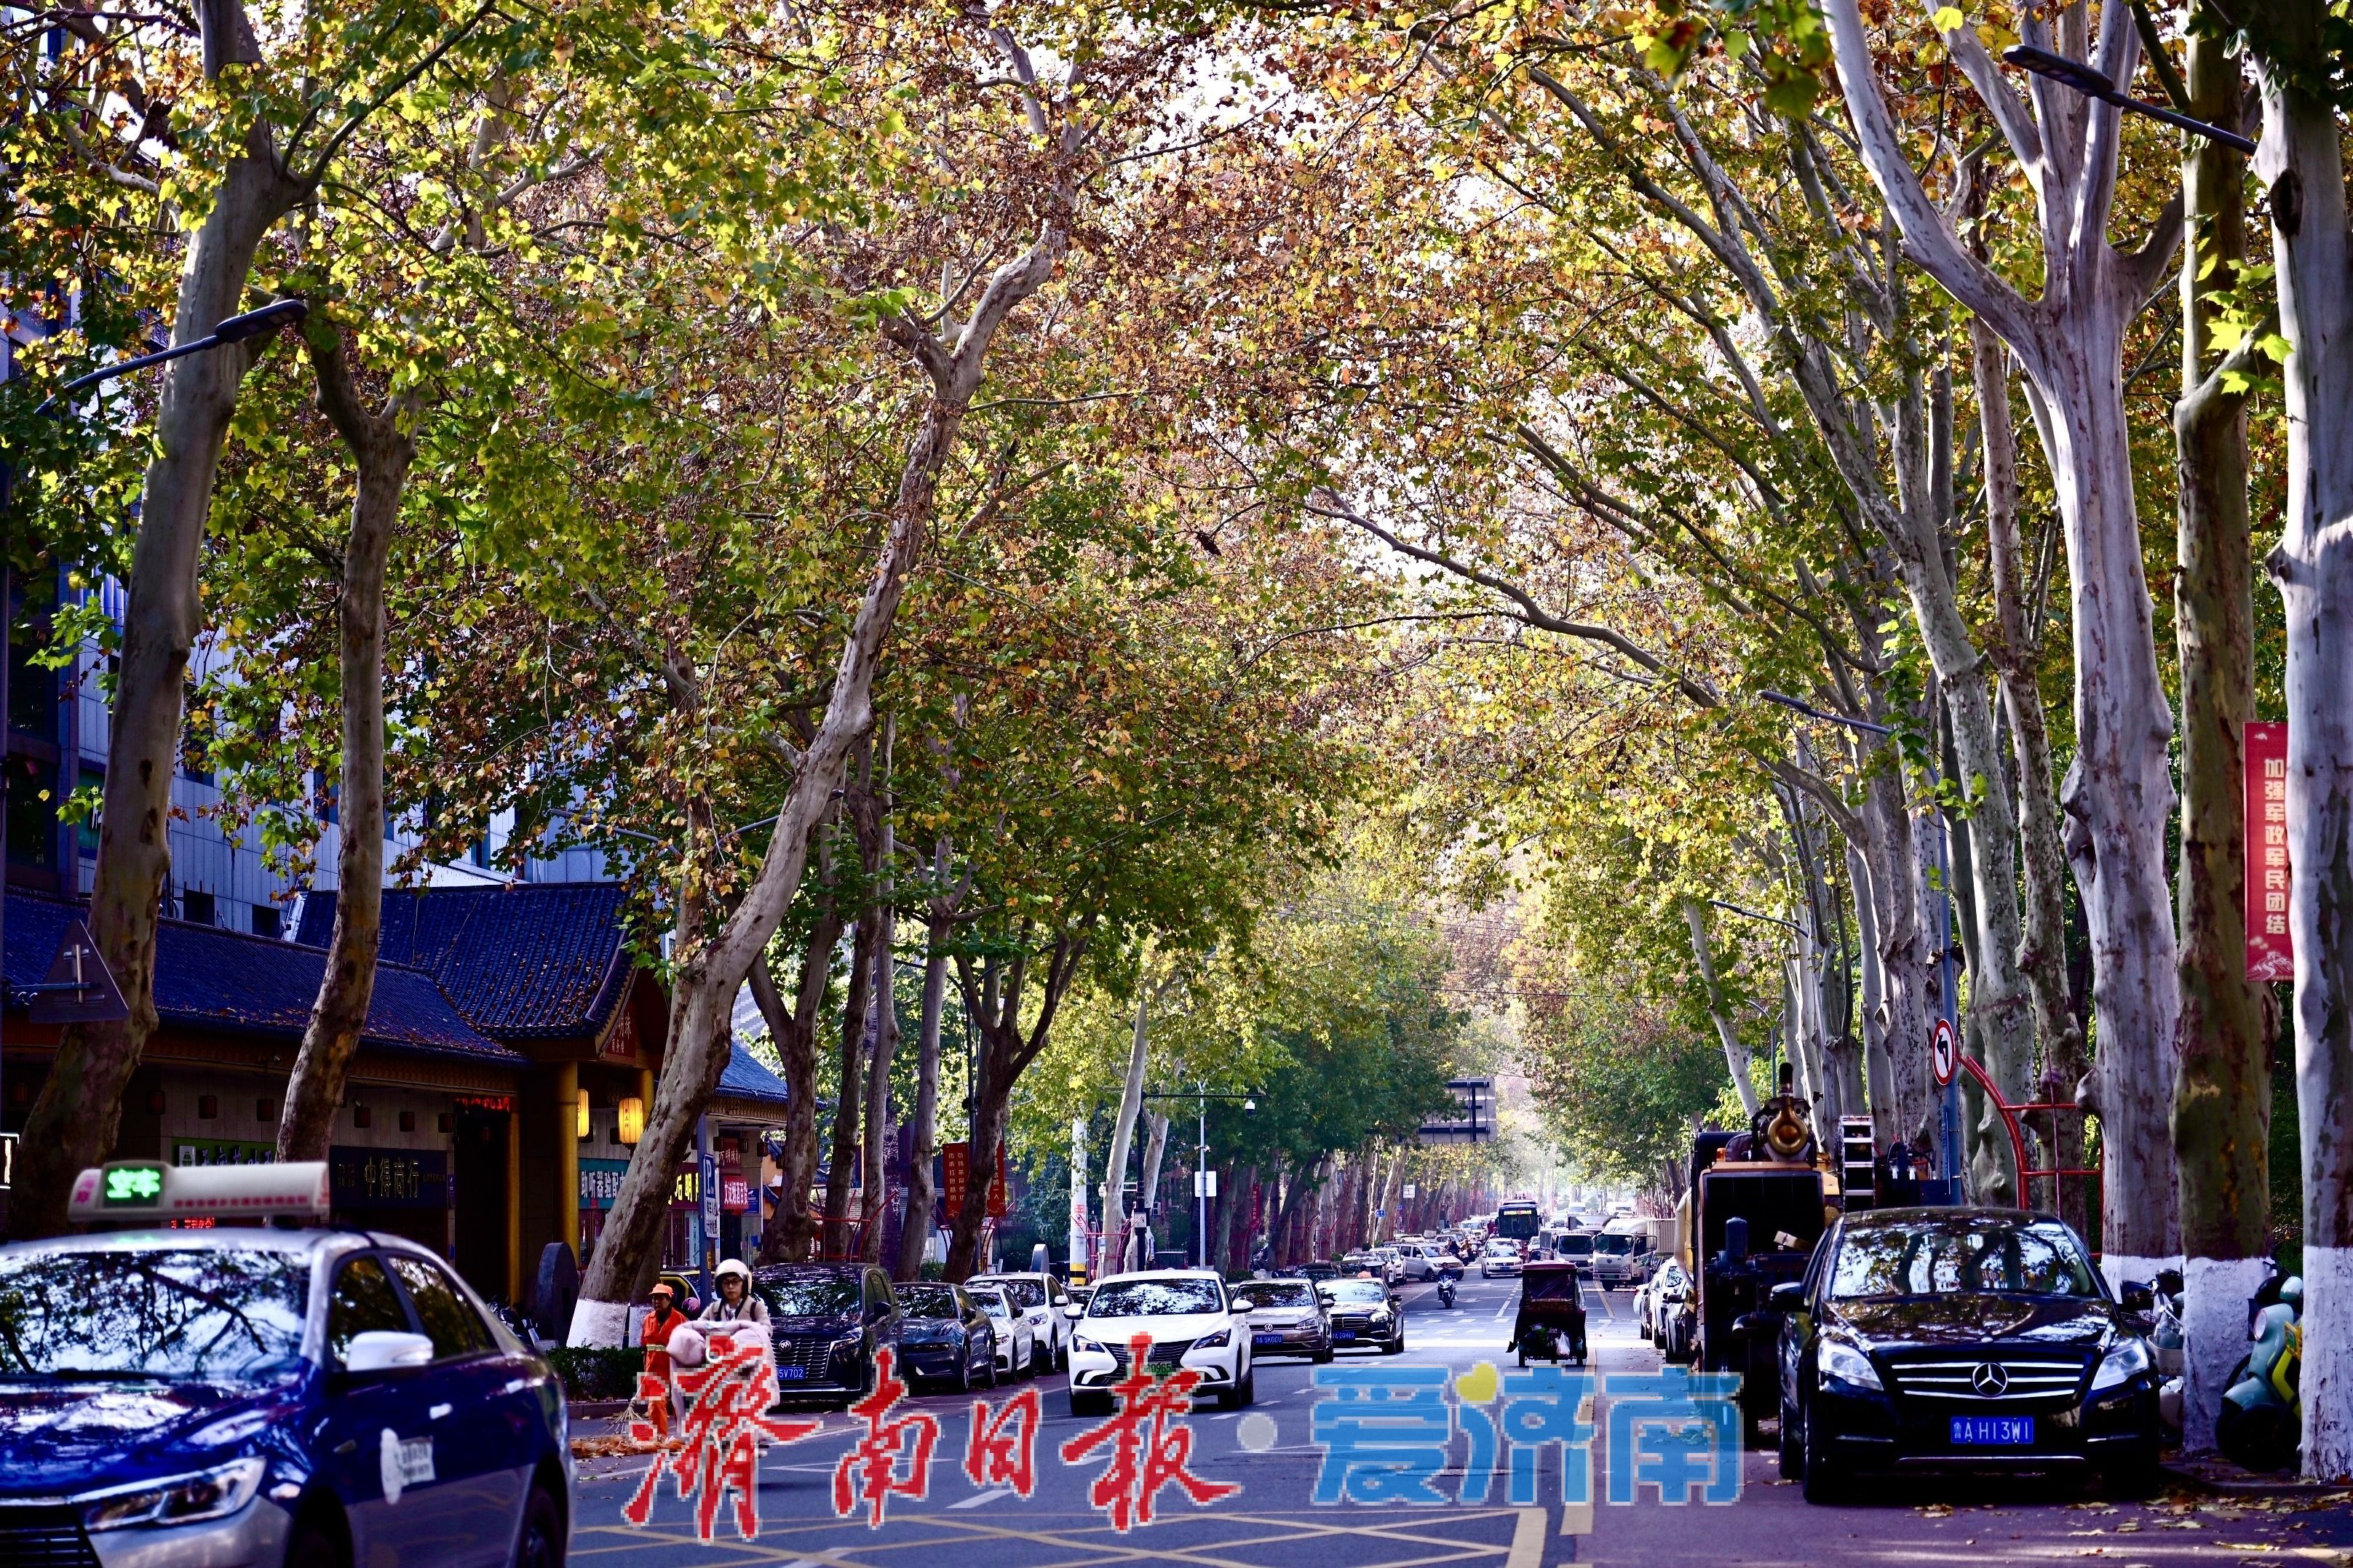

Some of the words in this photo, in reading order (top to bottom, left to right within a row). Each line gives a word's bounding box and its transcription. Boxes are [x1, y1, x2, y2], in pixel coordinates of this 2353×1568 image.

[2264, 758, 2285, 935] 加强军政军民团结
[107, 1169, 160, 1198] 空车
[705, 1159, 712, 1195] P
